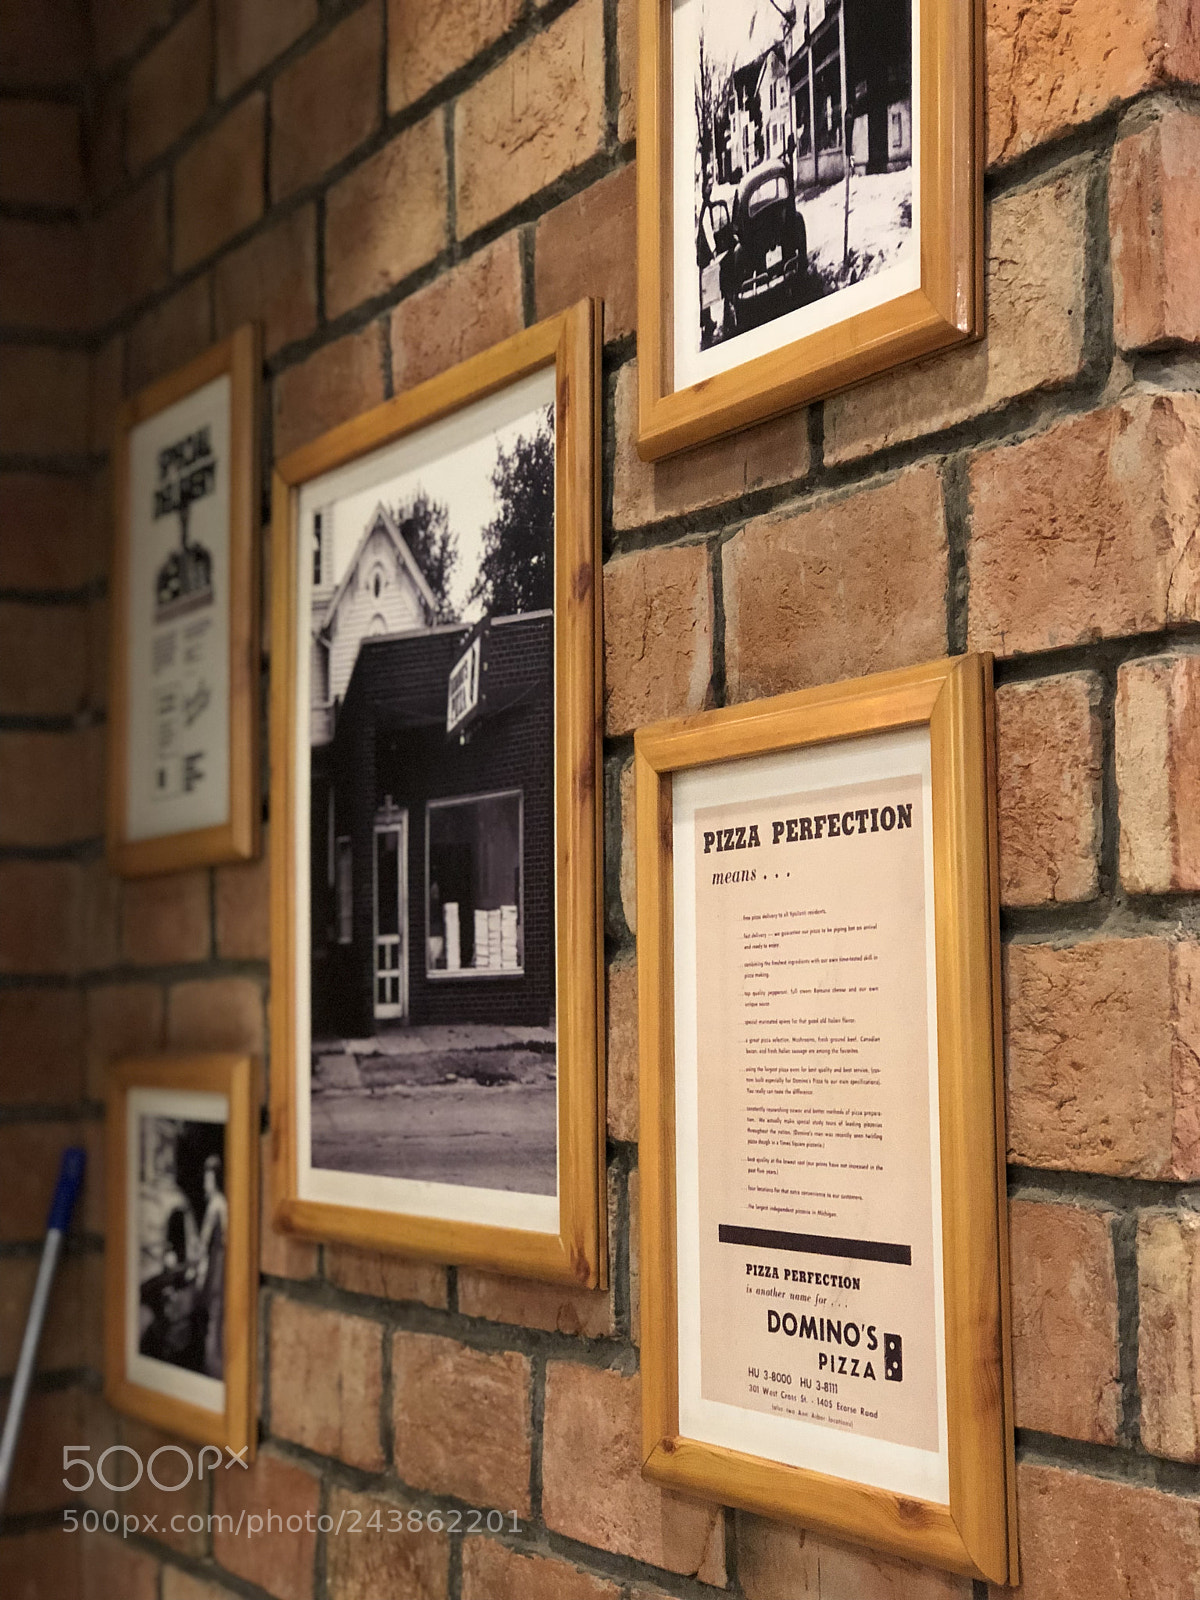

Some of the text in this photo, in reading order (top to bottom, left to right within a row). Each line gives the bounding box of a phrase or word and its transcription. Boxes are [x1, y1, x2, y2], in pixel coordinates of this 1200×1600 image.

[703, 803, 913, 854] PIZZA PERFECTION
[746, 1263, 861, 1291] PIZZA PERFECTION
[756, 1288, 786, 1299] another
[768, 1309, 879, 1351] DOMINO'S
[748, 1367, 838, 1395] HU 3-8000 HU 3-8111
[819, 1352, 877, 1381] PIZZA
[748, 1384, 759, 1395] 301
[763, 1386, 778, 1397] West
[781, 1391, 797, 1402] Cross
[817, 1397, 833, 1409] 1405
[861, 1407, 879, 1420] Road
